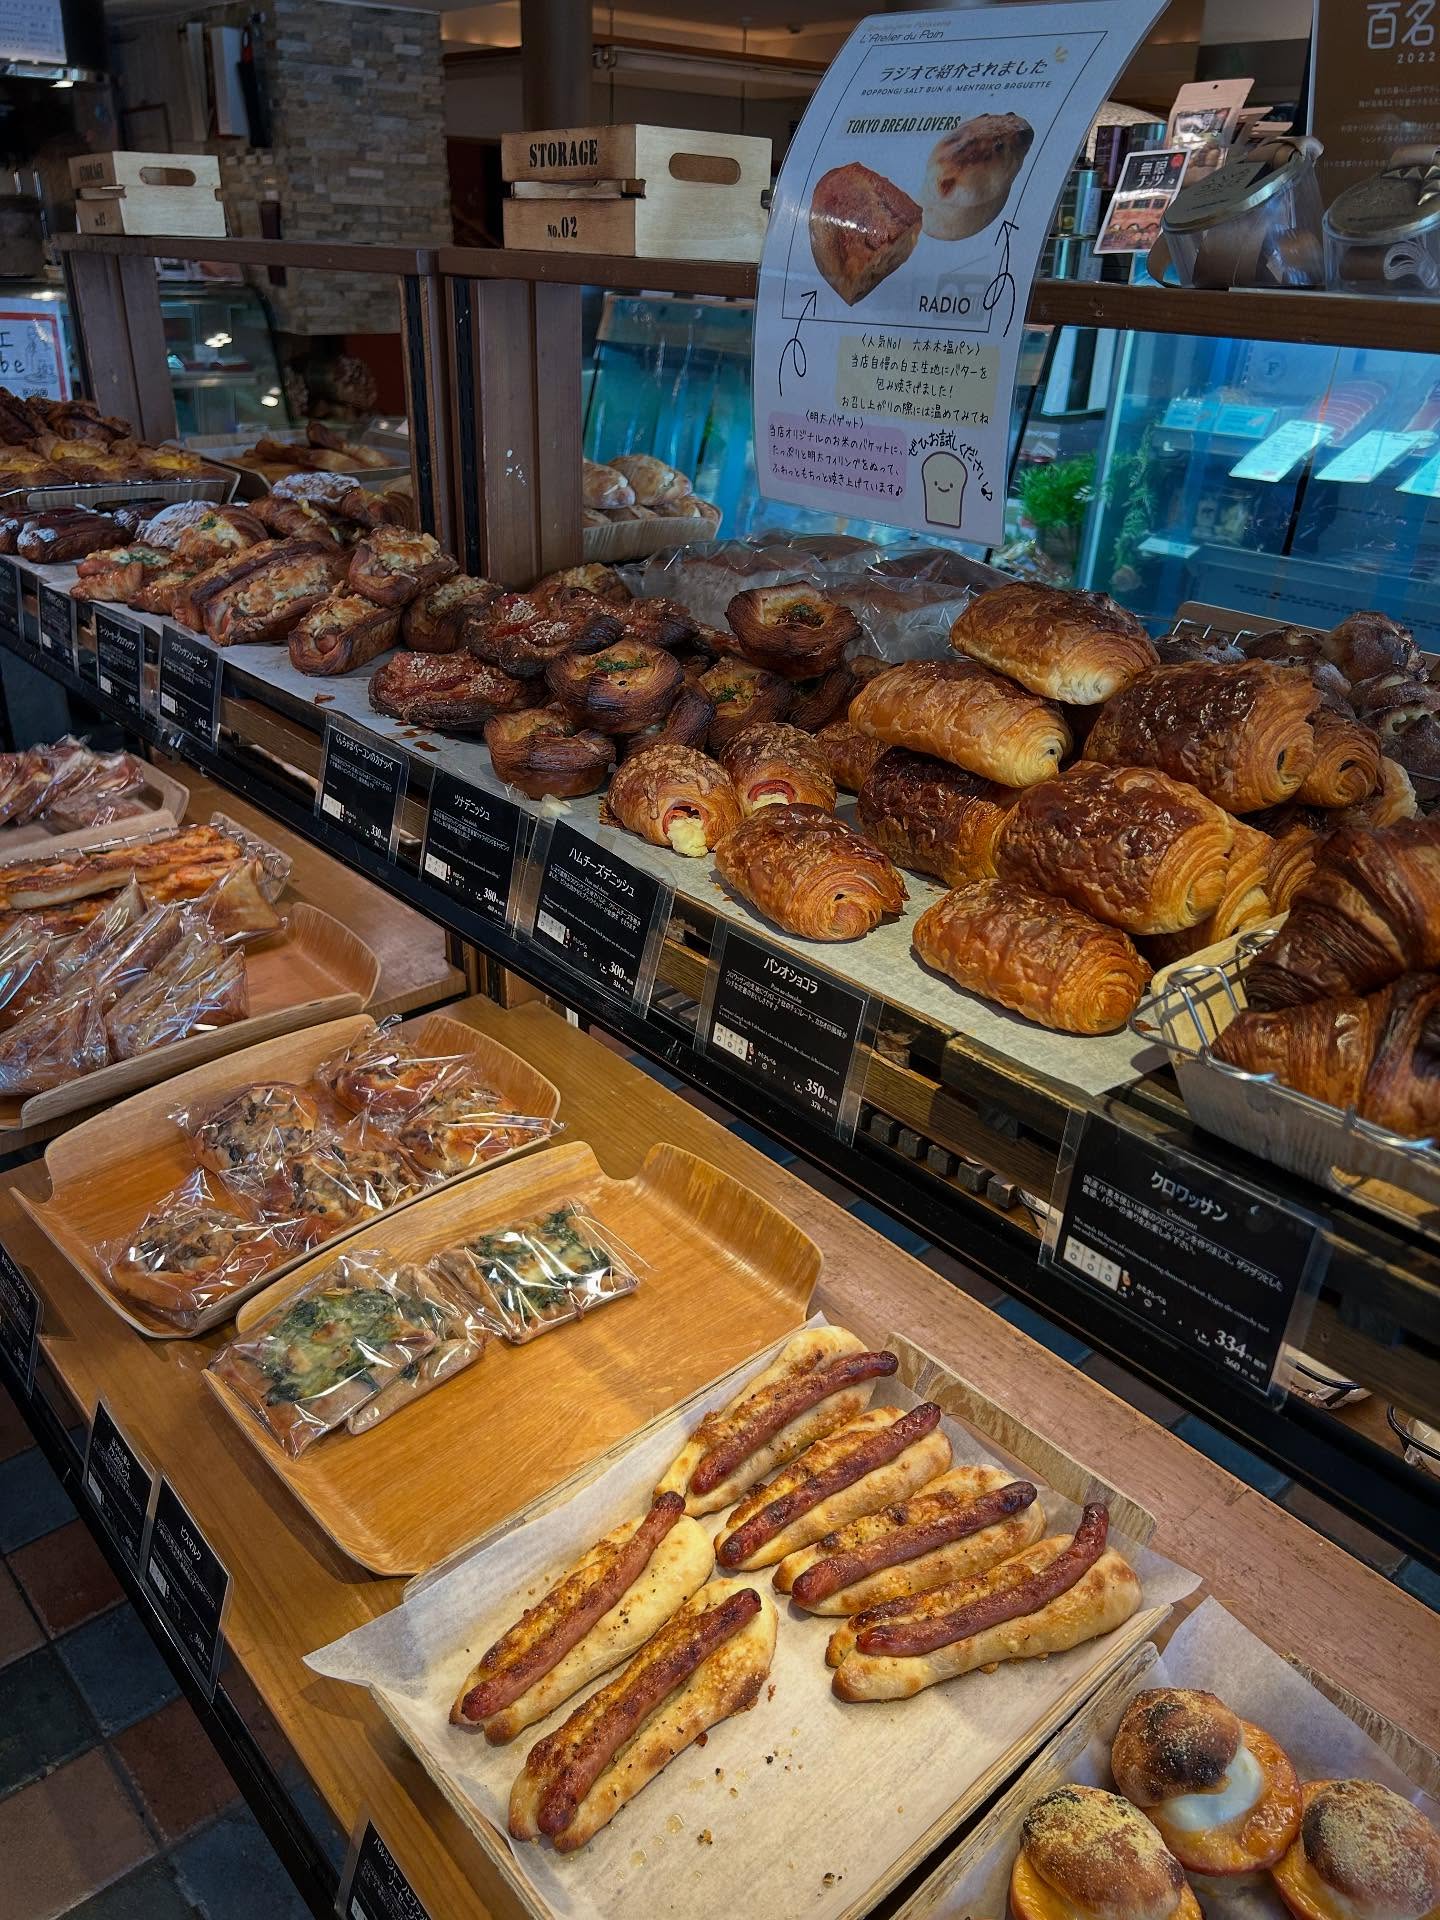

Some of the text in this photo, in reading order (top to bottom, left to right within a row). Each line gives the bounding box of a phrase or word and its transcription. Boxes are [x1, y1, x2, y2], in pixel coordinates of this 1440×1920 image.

[919, 30, 944, 40] Pain
[1397, 52, 1436, 64] 2022
[880, 58, 1048, 82] ラジオで紹介されました
[904, 86, 923, 94] SALT
[956, 83, 1002, 92] MENTAIKO
[1004, 80, 1054, 89] BAGUETTE
[846, 116, 961, 134] TOKYO BREAD LOVERS
[529, 139, 598, 168] STORAGE
[1138, 161, 1168, 176] 無限
[548, 216, 578, 238] No.02
[918, 295, 970, 315] RADIO
[454, 794, 490, 821] ツナデニッシュ
[568, 847, 635, 898] ハムチーズデニッシュ
[484, 888, 496, 902] 380
[609, 961, 624, 978] 300
[764, 956, 818, 994] パンオショコラ
[805, 1079, 825, 1098] 350
[1150, 1171, 1228, 1222] クロワッサン
[1214, 1330, 1246, 1358] 334
[1224, 1356, 1240, 1371] 360
[180, 1525, 202, 1561] ビスマルク
